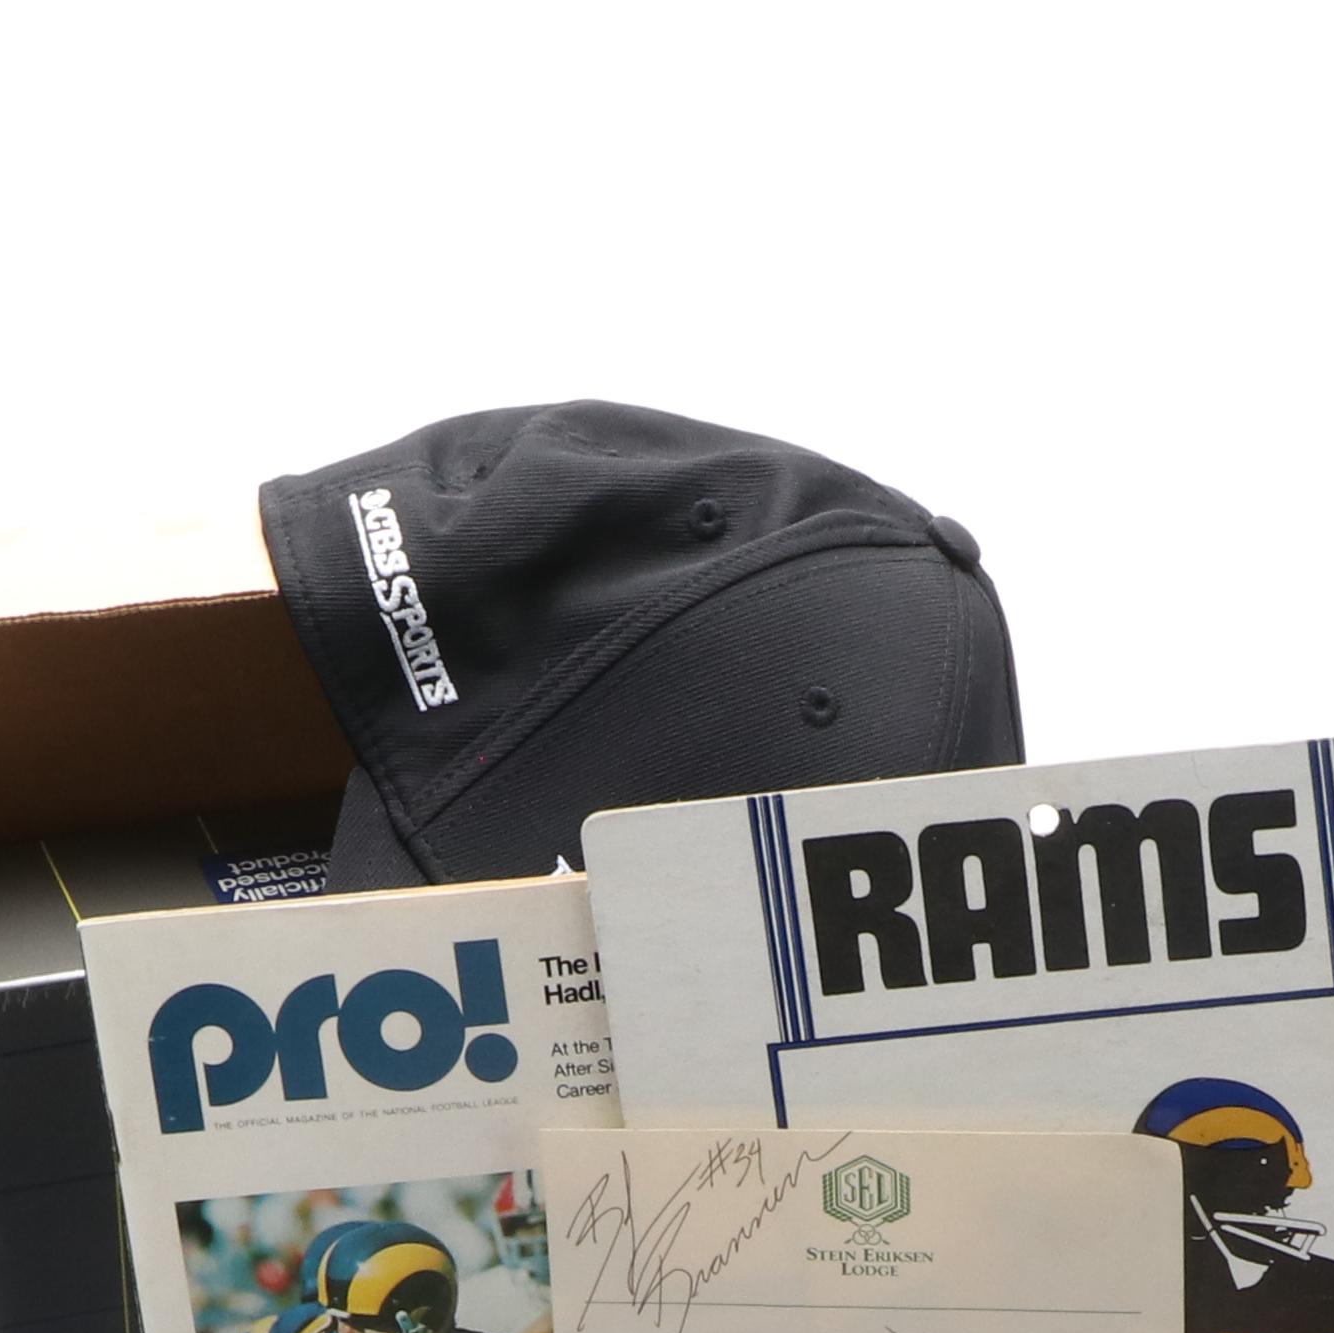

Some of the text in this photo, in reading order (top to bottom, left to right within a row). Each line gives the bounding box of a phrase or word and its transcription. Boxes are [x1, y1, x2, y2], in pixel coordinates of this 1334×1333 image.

[364, 508, 459, 707] CBS SPORTS
[802, 789, 1307, 997] RAMS
[539, 956, 588, 978] The
[148, 938, 518, 1134] pro!
[551, 1040, 599, 1057] At the
[555, 1063, 592, 1078] After
[557, 1082, 611, 1099] Career
[237, 1117, 281, 1128] OFFICIAL
[286, 1112, 337, 1125] MAGAZINE
[342, 1111, 354, 1120] OF
[360, 1109, 378, 1119] THE
[382, 1105, 428, 1117] NATIONAL
[431, 1101, 479, 1113] FOOTBALL
